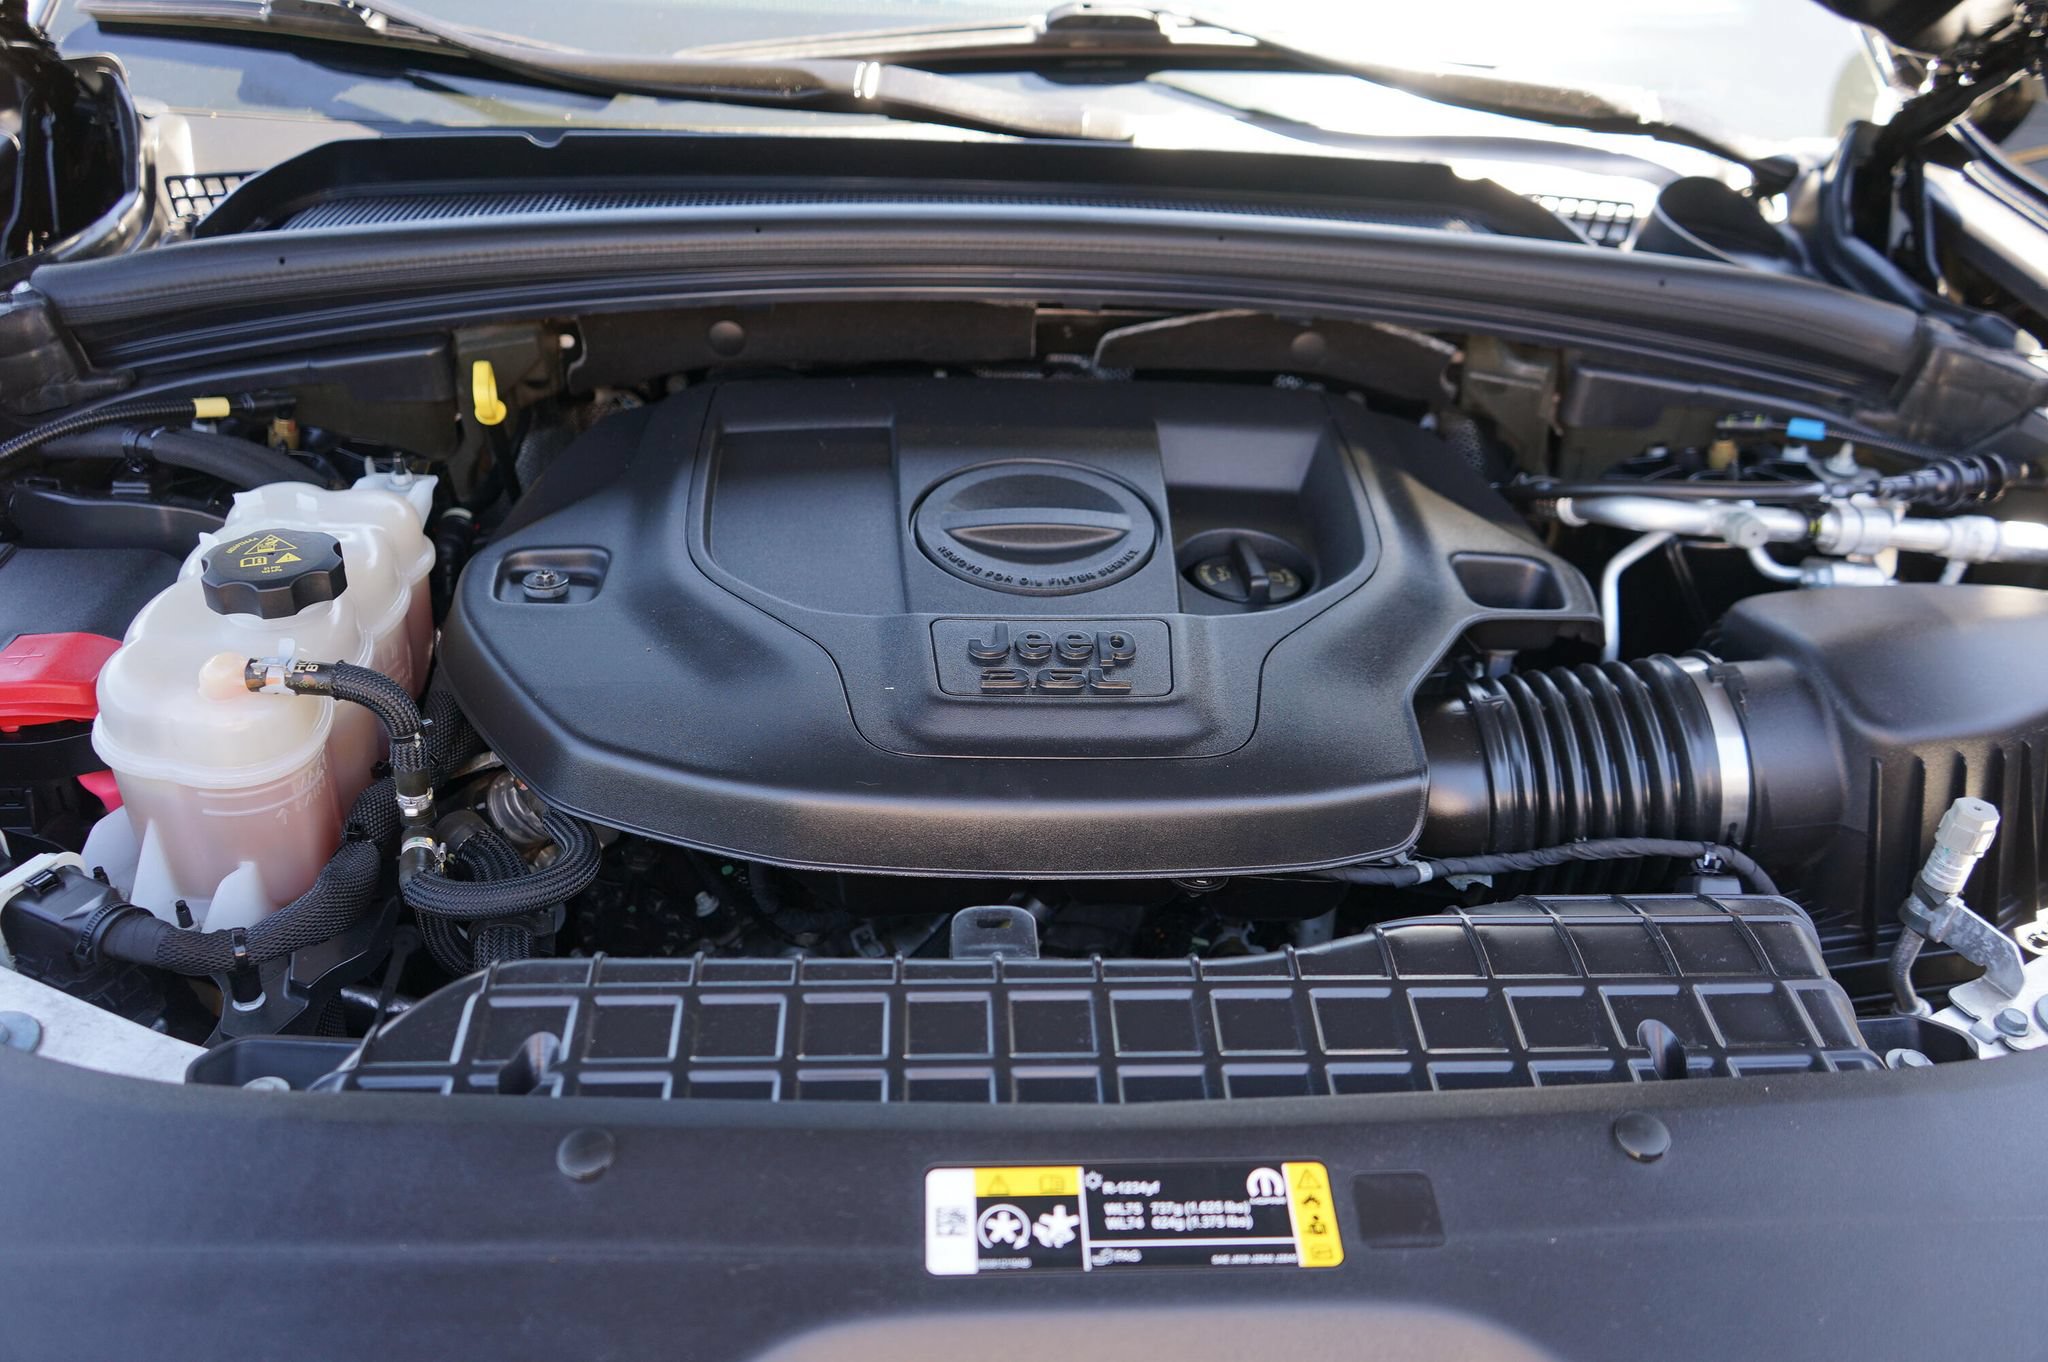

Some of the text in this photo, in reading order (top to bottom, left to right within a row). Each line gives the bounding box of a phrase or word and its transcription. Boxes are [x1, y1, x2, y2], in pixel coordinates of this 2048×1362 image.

[937, 546, 982, 575] REMOVE
[985, 571, 1013, 584] FOR
[1019, 577, 1042, 587] OIL
[1048, 572, 1096, 586] FILTER
[967, 622, 1137, 667] Jeep
